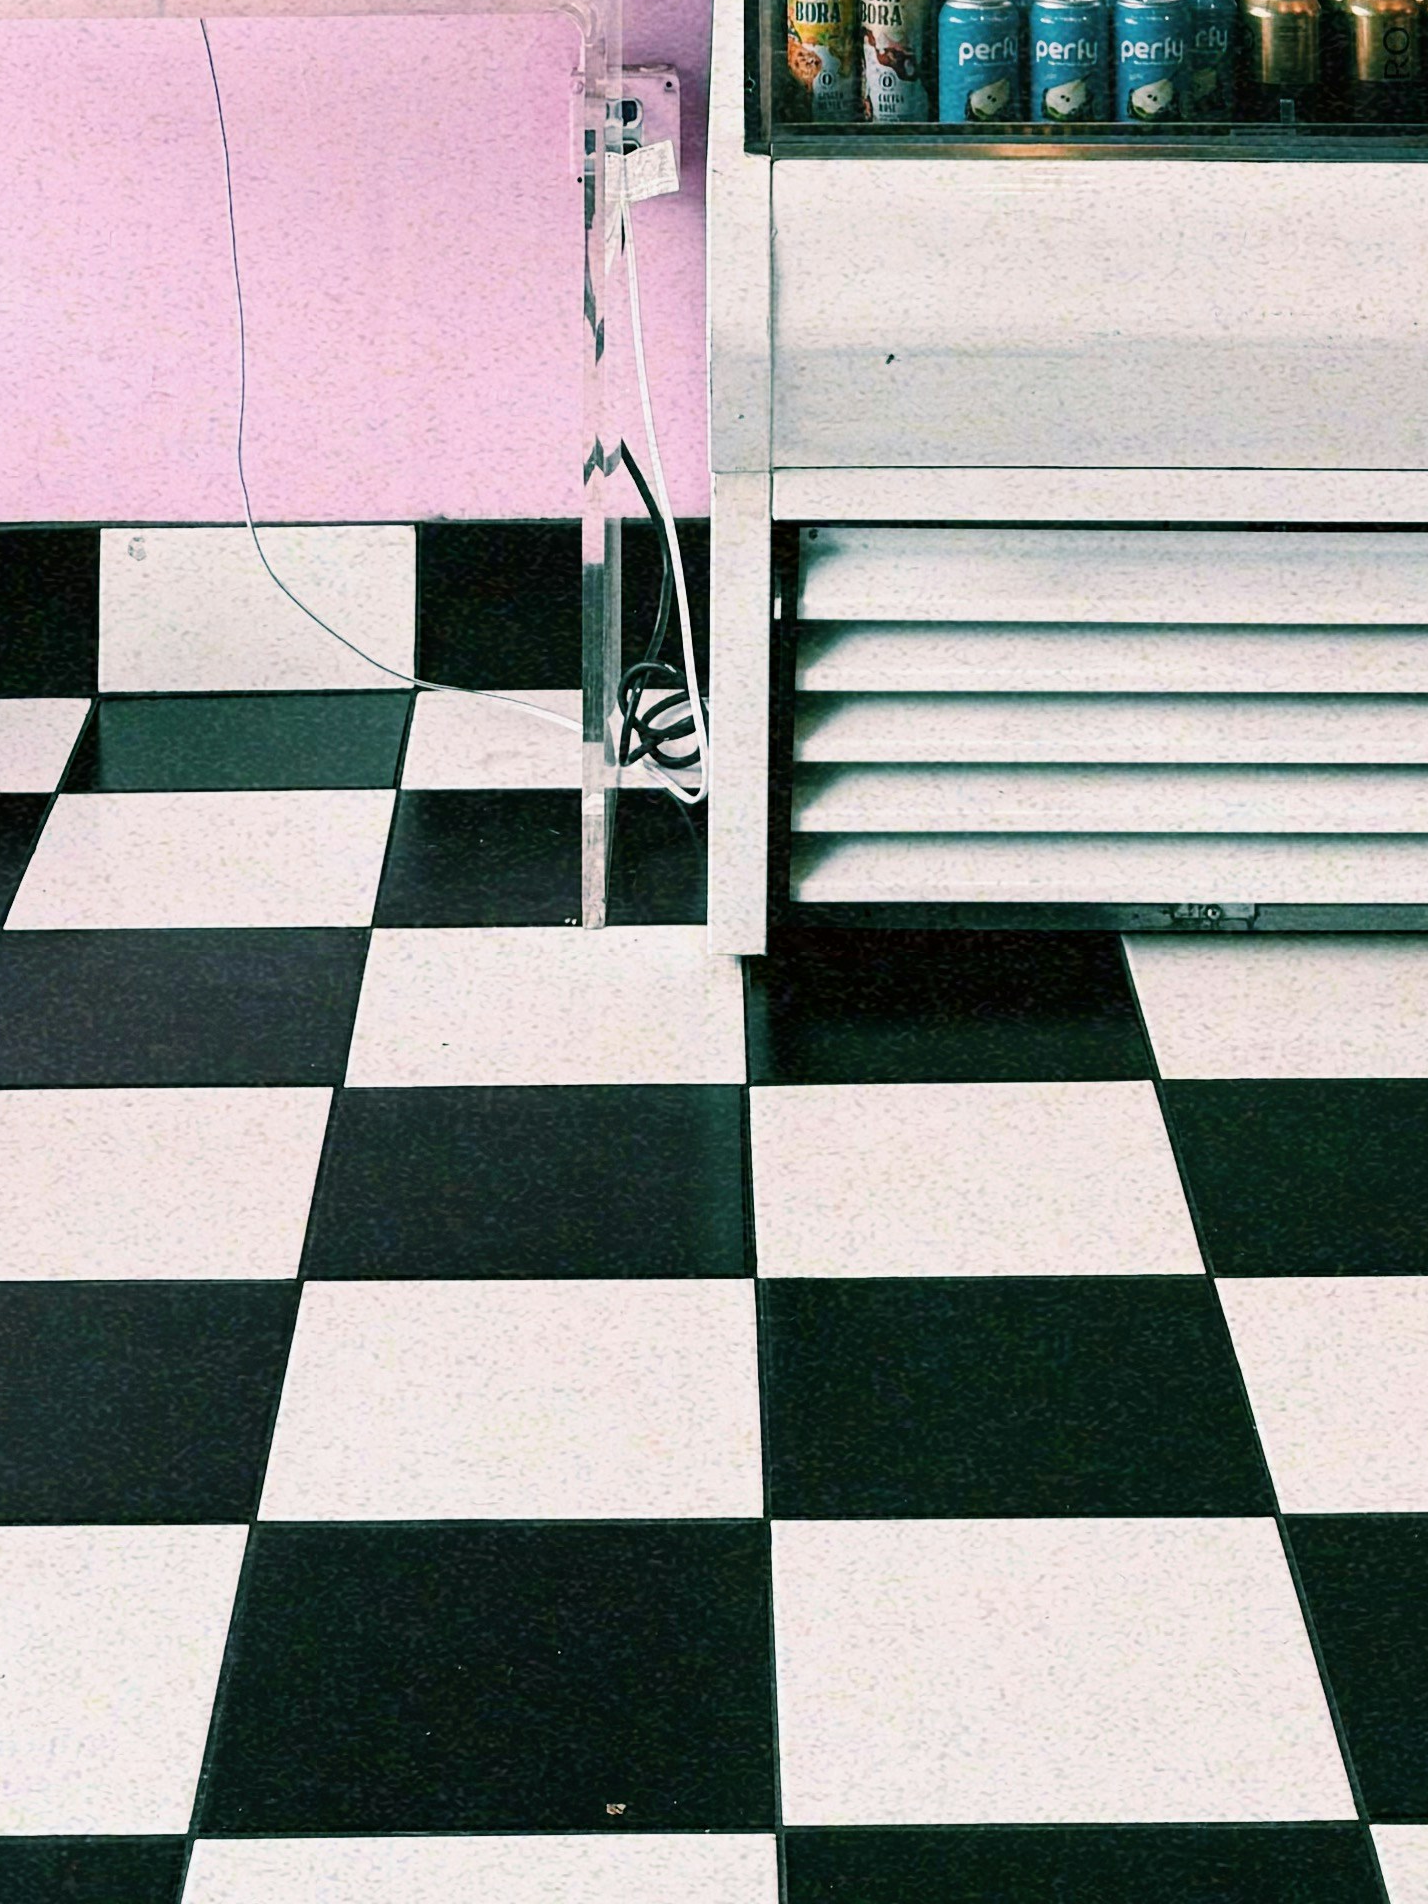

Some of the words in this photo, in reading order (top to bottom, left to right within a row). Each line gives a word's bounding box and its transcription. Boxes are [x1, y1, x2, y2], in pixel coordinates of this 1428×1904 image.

[795, 1, 842, 24] BORA
[861, 3, 903, 26] BORA
[958, 38, 1019, 67] perfy
[1035, 37, 1099, 63] perfy
[1120, 37, 1184, 63] perfy
